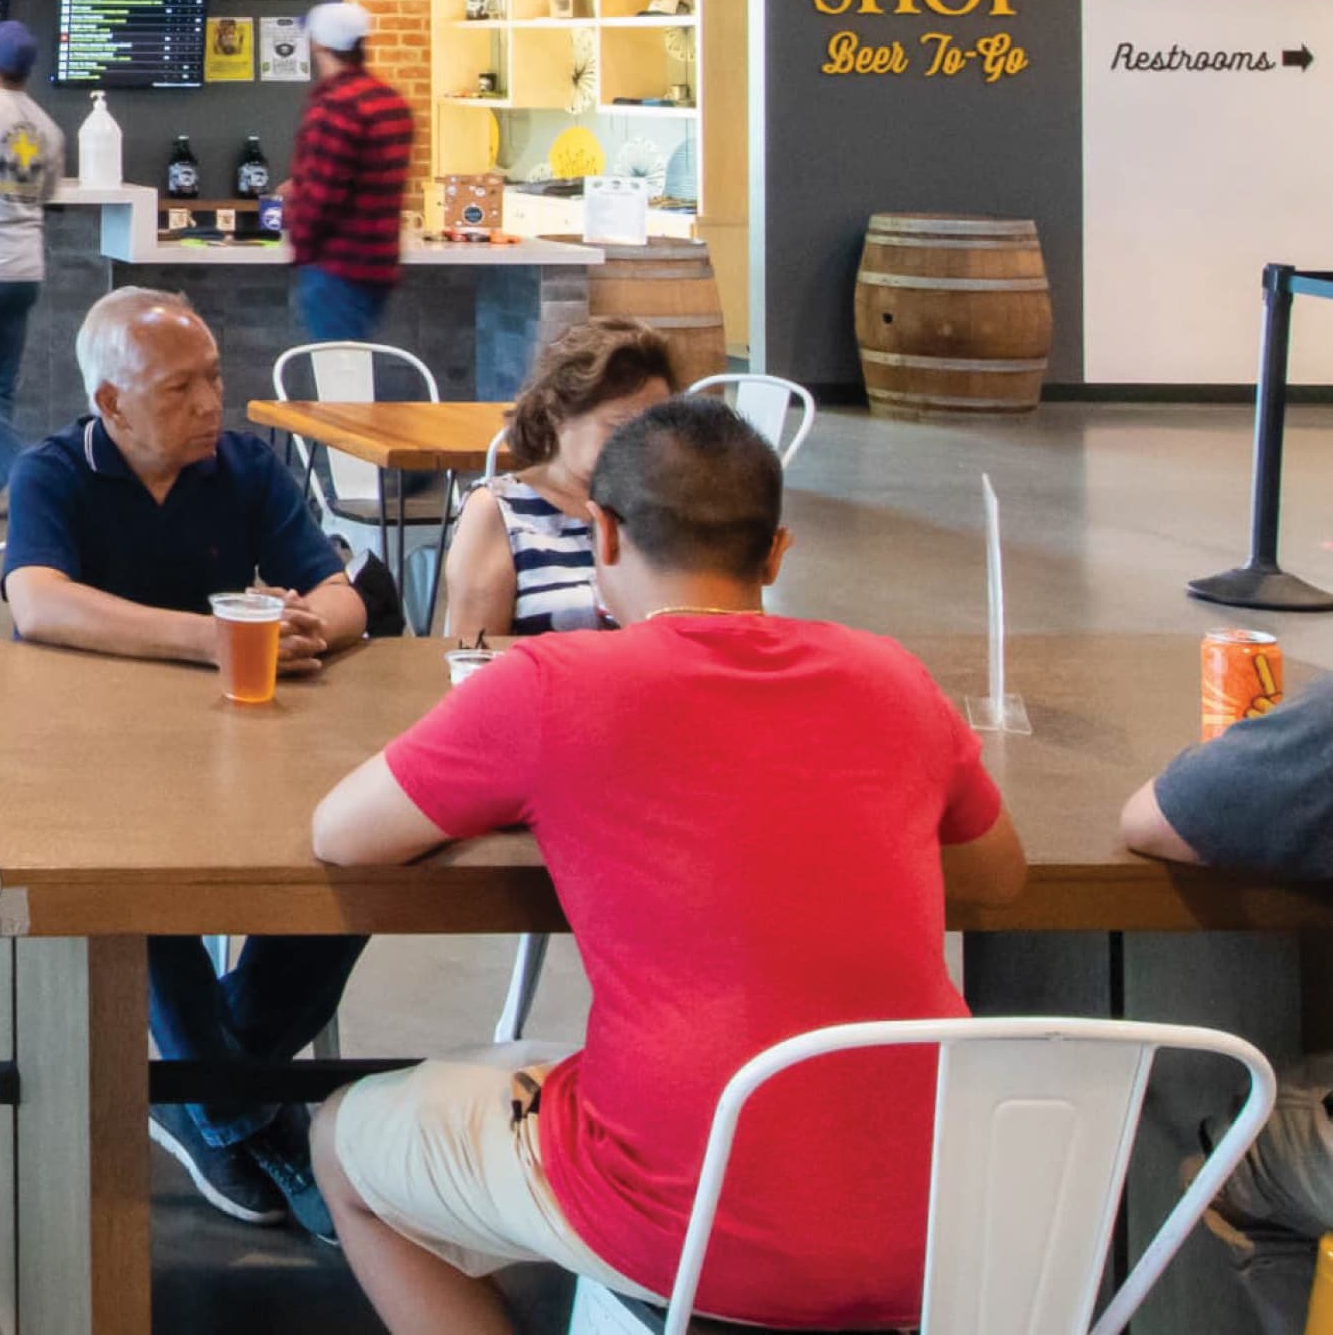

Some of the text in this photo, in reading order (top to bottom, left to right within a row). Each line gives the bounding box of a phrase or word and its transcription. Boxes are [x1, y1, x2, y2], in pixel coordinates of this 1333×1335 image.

[821, 30, 1029, 83] Beer To-Go
[1110, 42, 1277, 72] Restrooms
